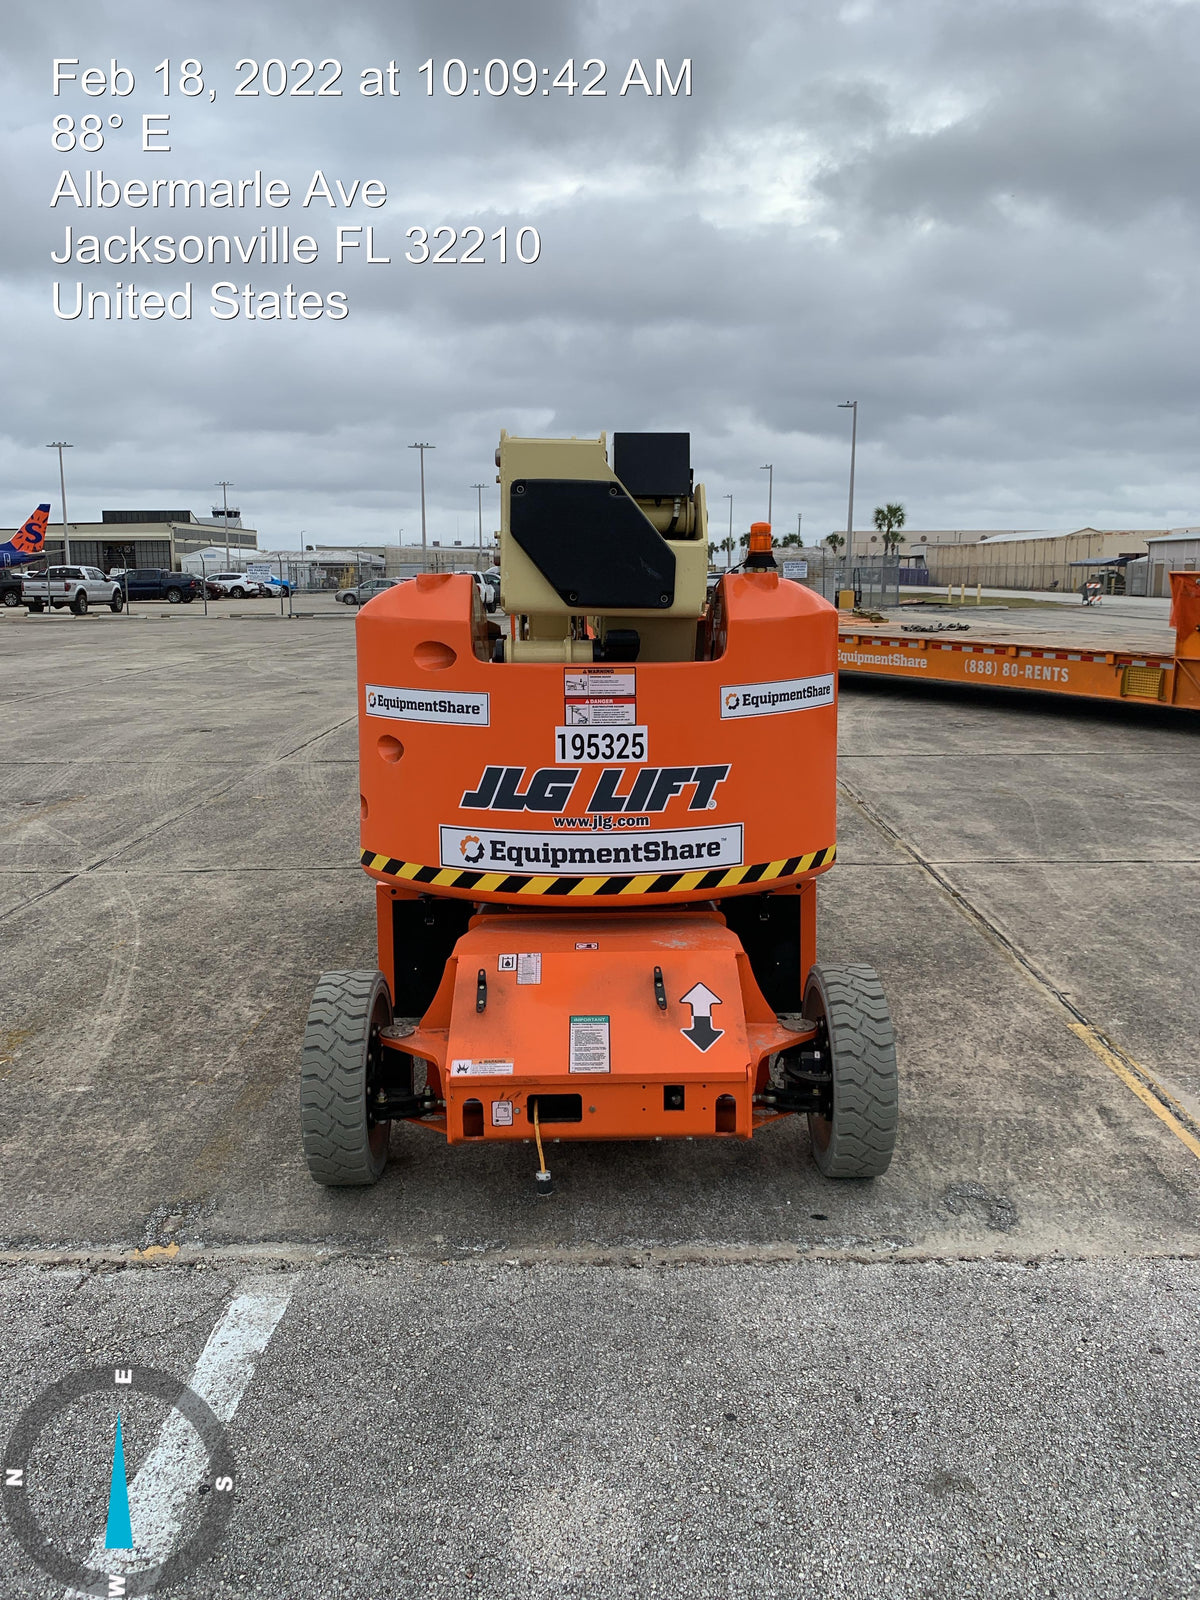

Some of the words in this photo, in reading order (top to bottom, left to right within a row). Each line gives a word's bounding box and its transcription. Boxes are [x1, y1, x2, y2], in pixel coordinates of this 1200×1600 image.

[964, 659, 998, 676] (888)
[1002, 662, 1070, 682] 80-RENTS
[556, 732, 646, 761] 195325
[459, 765, 582, 813] JLG
[553, 814, 651, 830] www.jlg.com
